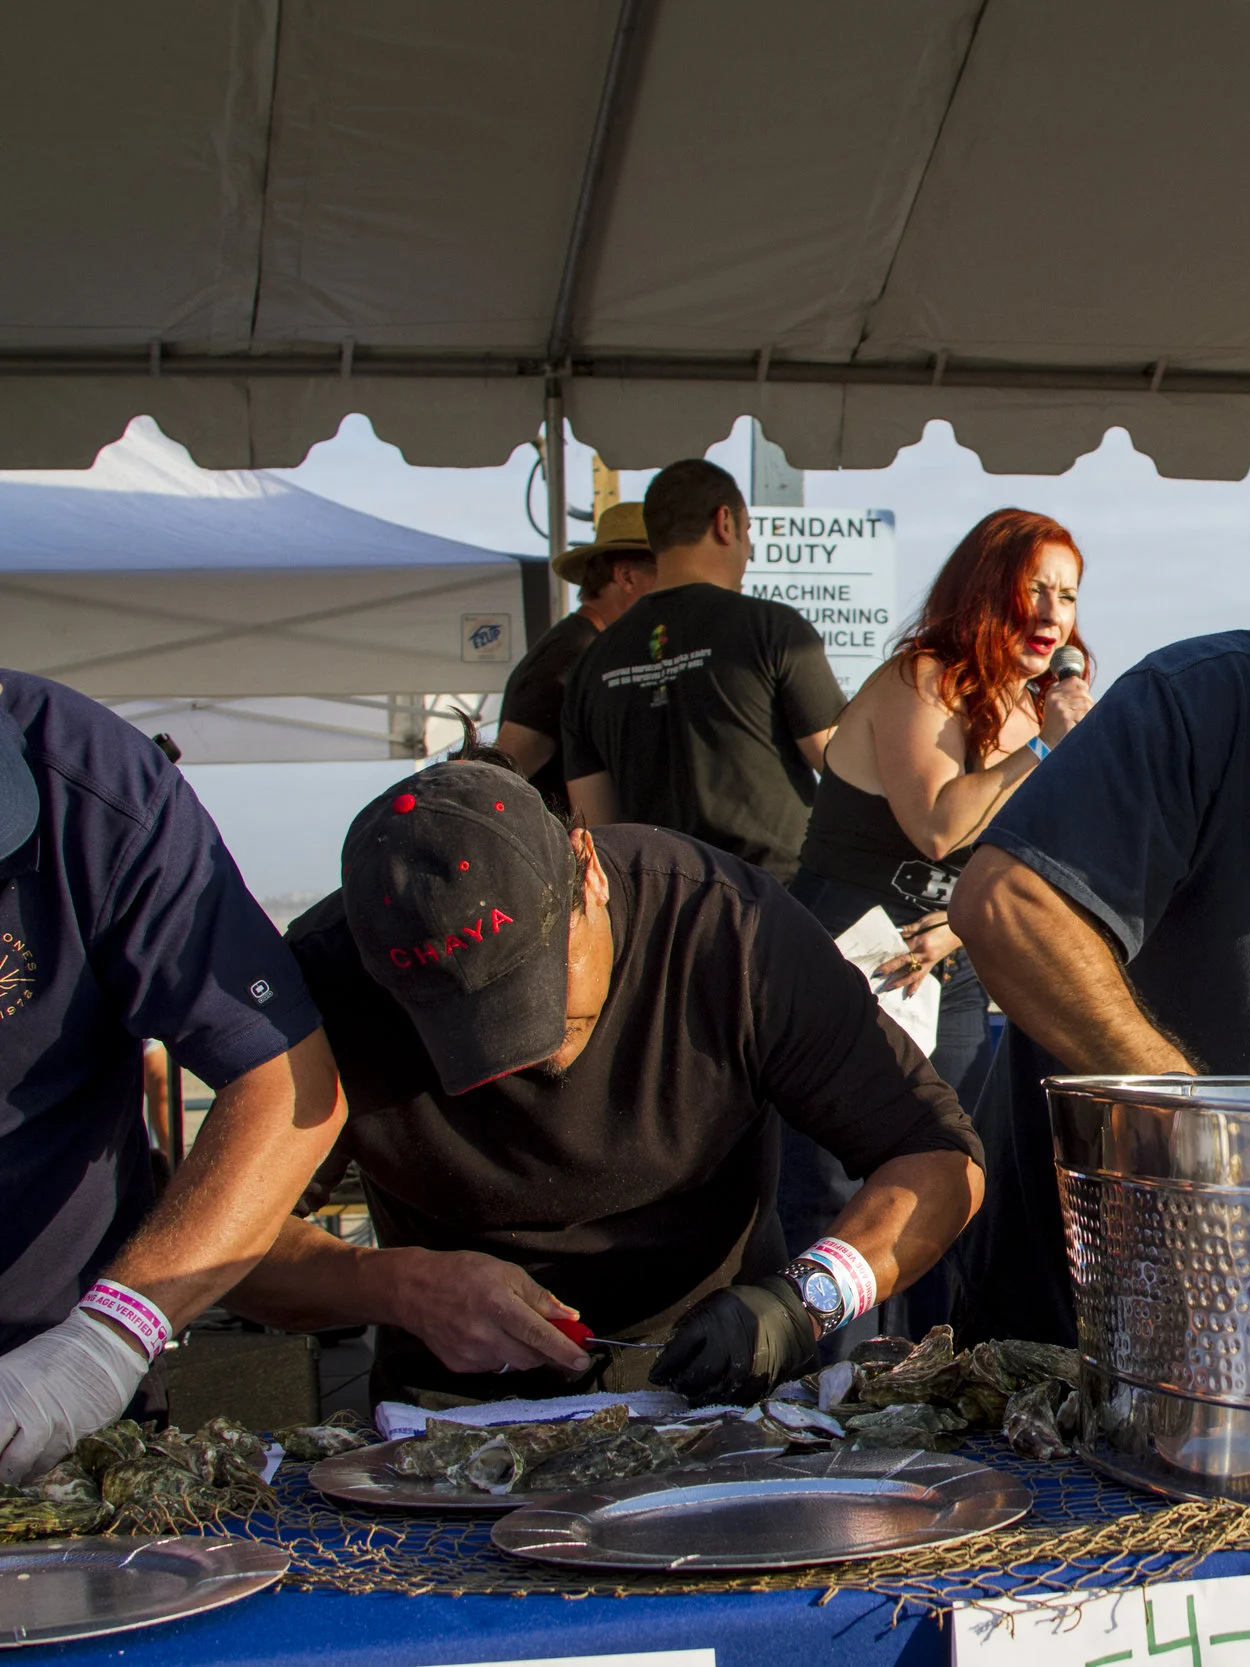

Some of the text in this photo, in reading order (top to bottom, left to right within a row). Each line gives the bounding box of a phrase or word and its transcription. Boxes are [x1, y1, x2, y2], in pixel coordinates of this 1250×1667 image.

[749, 516, 881, 538] TENDANT
[766, 544, 837, 564] DUTY
[752, 584, 851, 601] MACHINE
[798, 608, 889, 625] URNING
[822, 631, 875, 647] ICLE
[389, 908, 514, 969] CHAYA
[2, 932, 37, 972] ONES
[96, 1296, 153, 1337] AGE VERIFIED
